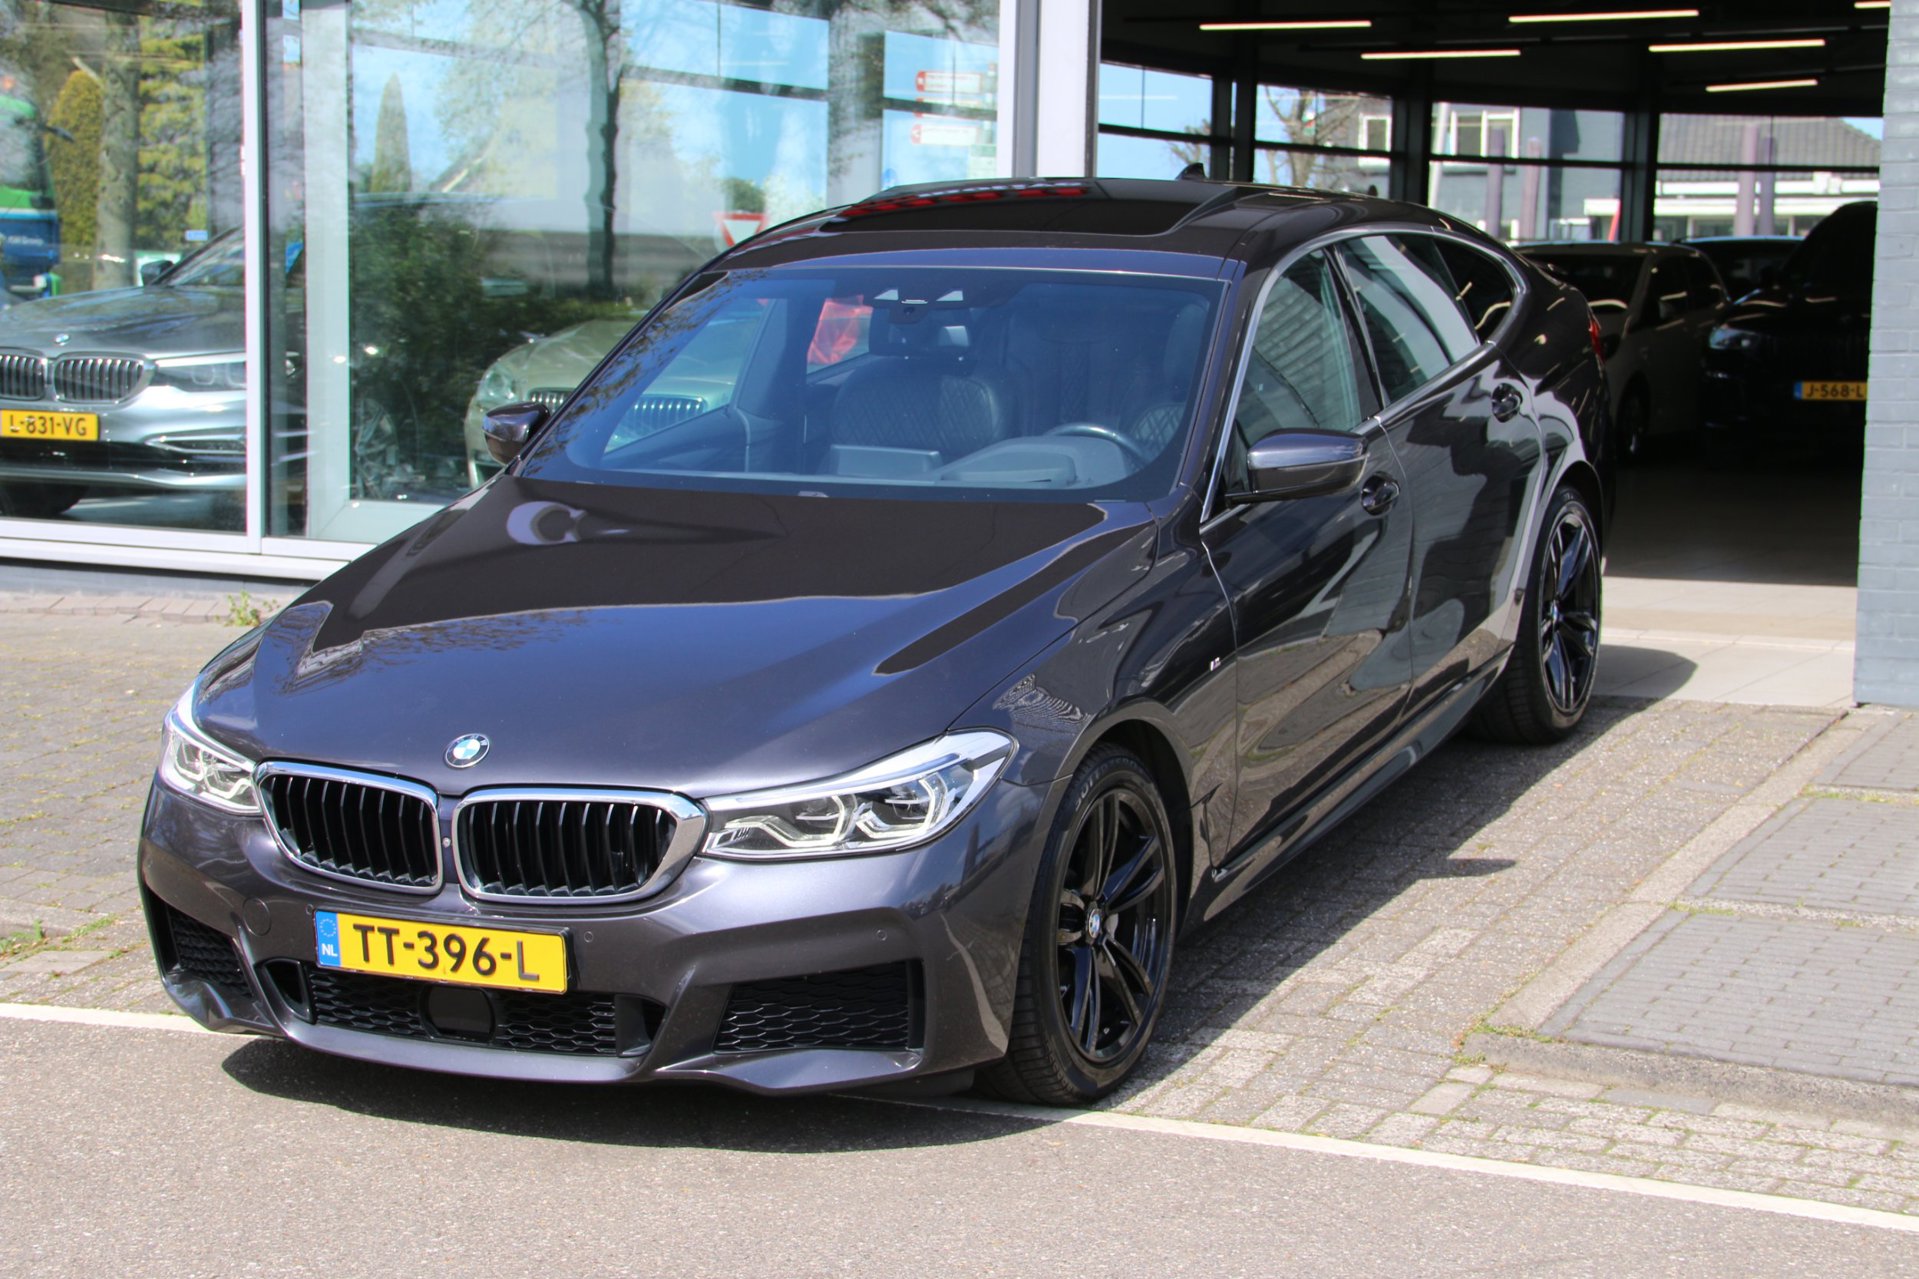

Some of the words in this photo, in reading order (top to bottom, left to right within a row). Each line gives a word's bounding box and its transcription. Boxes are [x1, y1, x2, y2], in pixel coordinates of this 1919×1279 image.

[1806, 383, 1864, 398] J-568-L
[9, 414, 87, 436] L-831-VG
[321, 943, 338, 957] NL
[352, 923, 540, 982] TT-396-L
